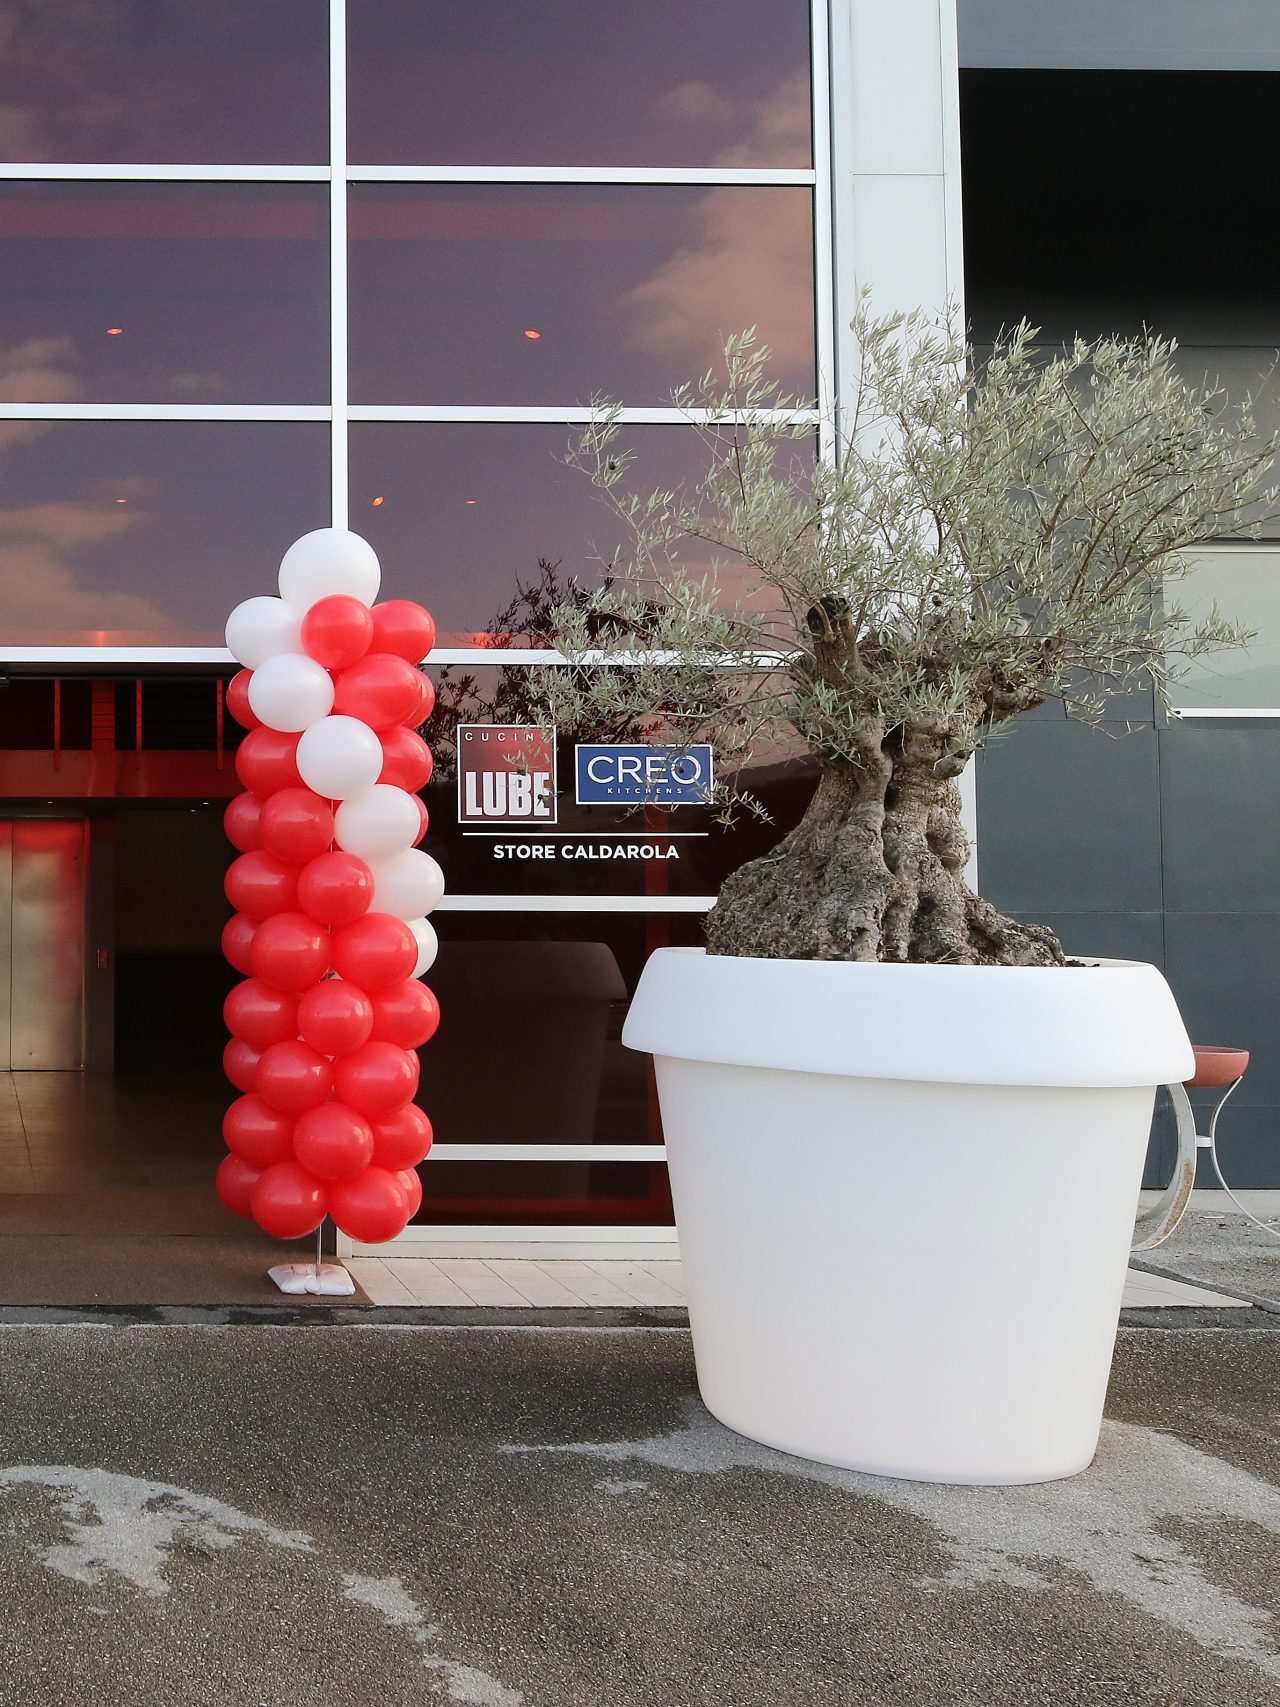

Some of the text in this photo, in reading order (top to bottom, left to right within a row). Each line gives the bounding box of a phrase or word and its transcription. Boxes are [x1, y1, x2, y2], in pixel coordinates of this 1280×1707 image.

[464, 732, 549, 742] CUCIN
[587, 755, 702, 785] CREO
[465, 771, 551, 816] LUBE
[493, 844, 680, 860] STORE CALDAROLA
